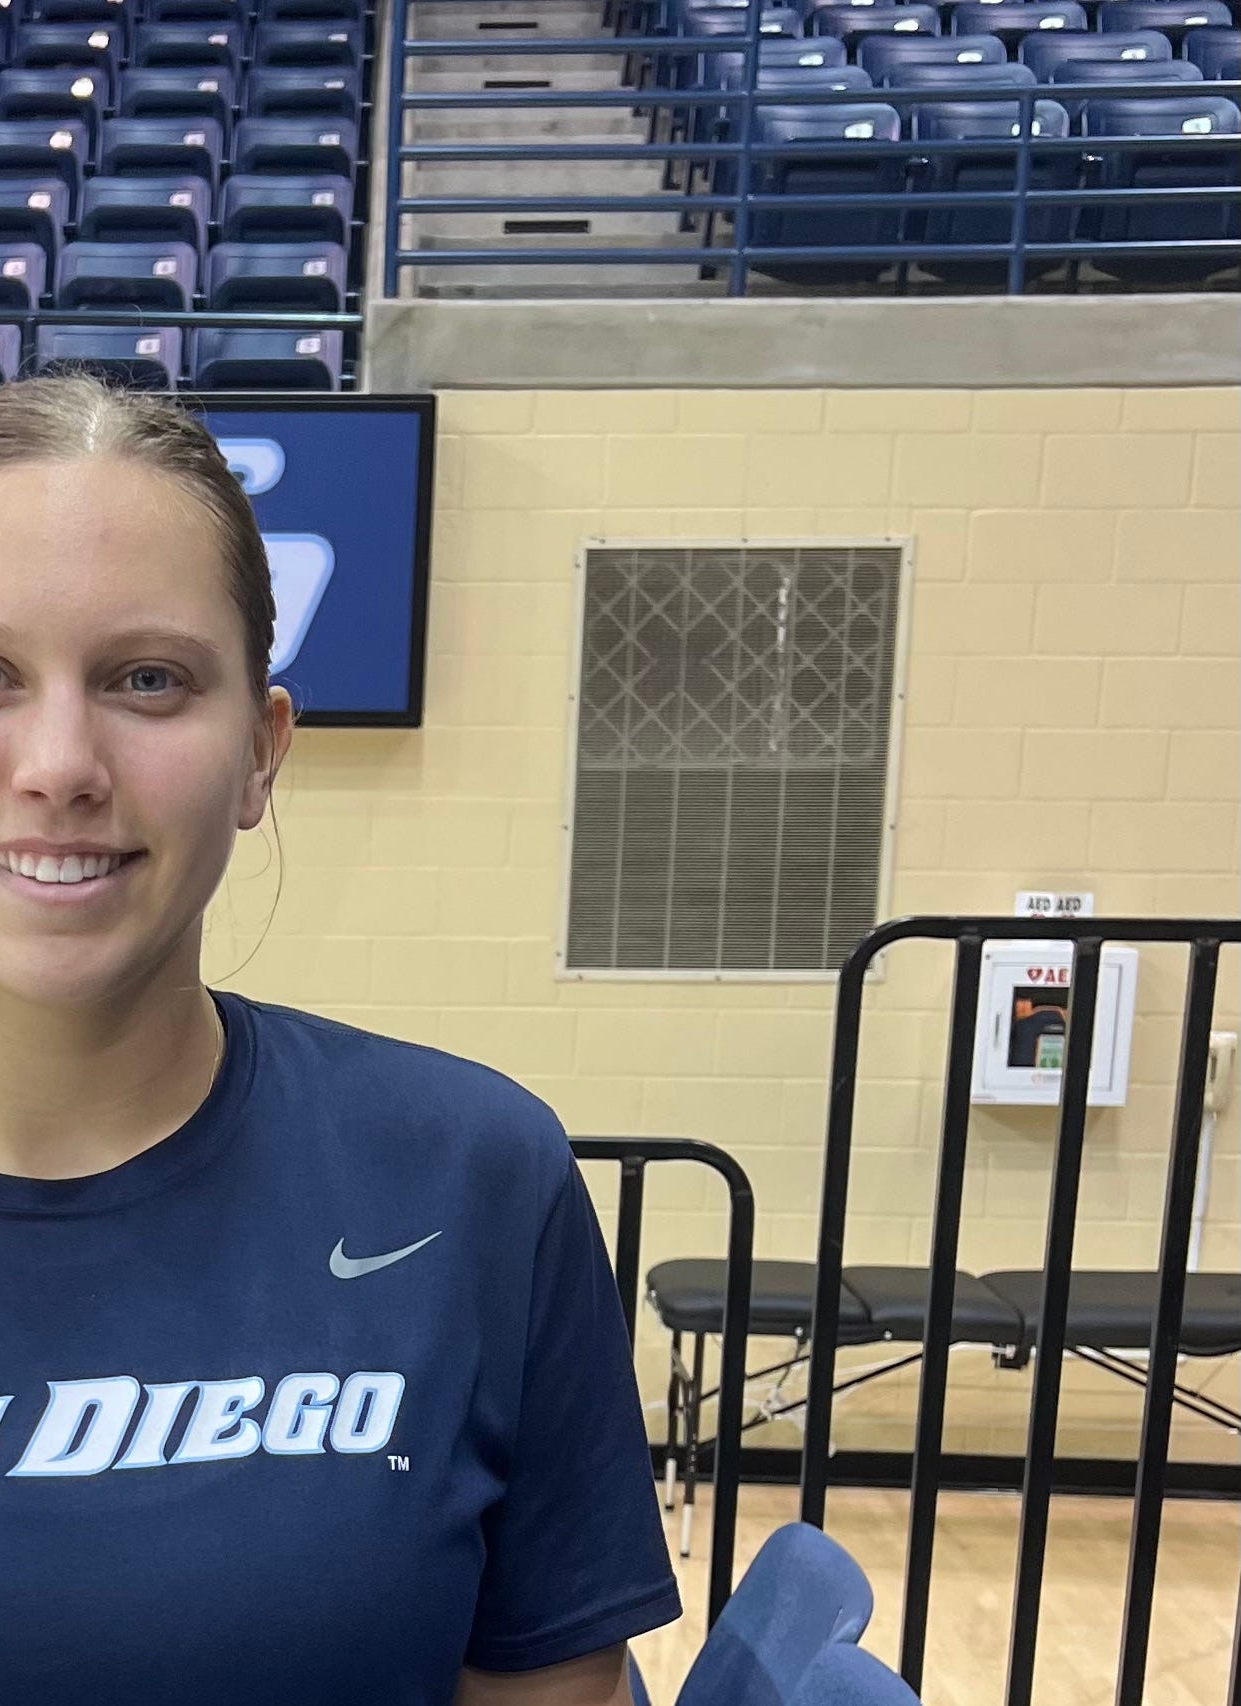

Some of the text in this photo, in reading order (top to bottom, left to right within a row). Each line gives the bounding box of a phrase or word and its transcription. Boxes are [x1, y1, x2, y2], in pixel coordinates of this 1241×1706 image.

[1045, 967, 1070, 983] AE
[5, 1371, 406, 1477] DIEGO
[387, 1455, 410, 1472] TM
